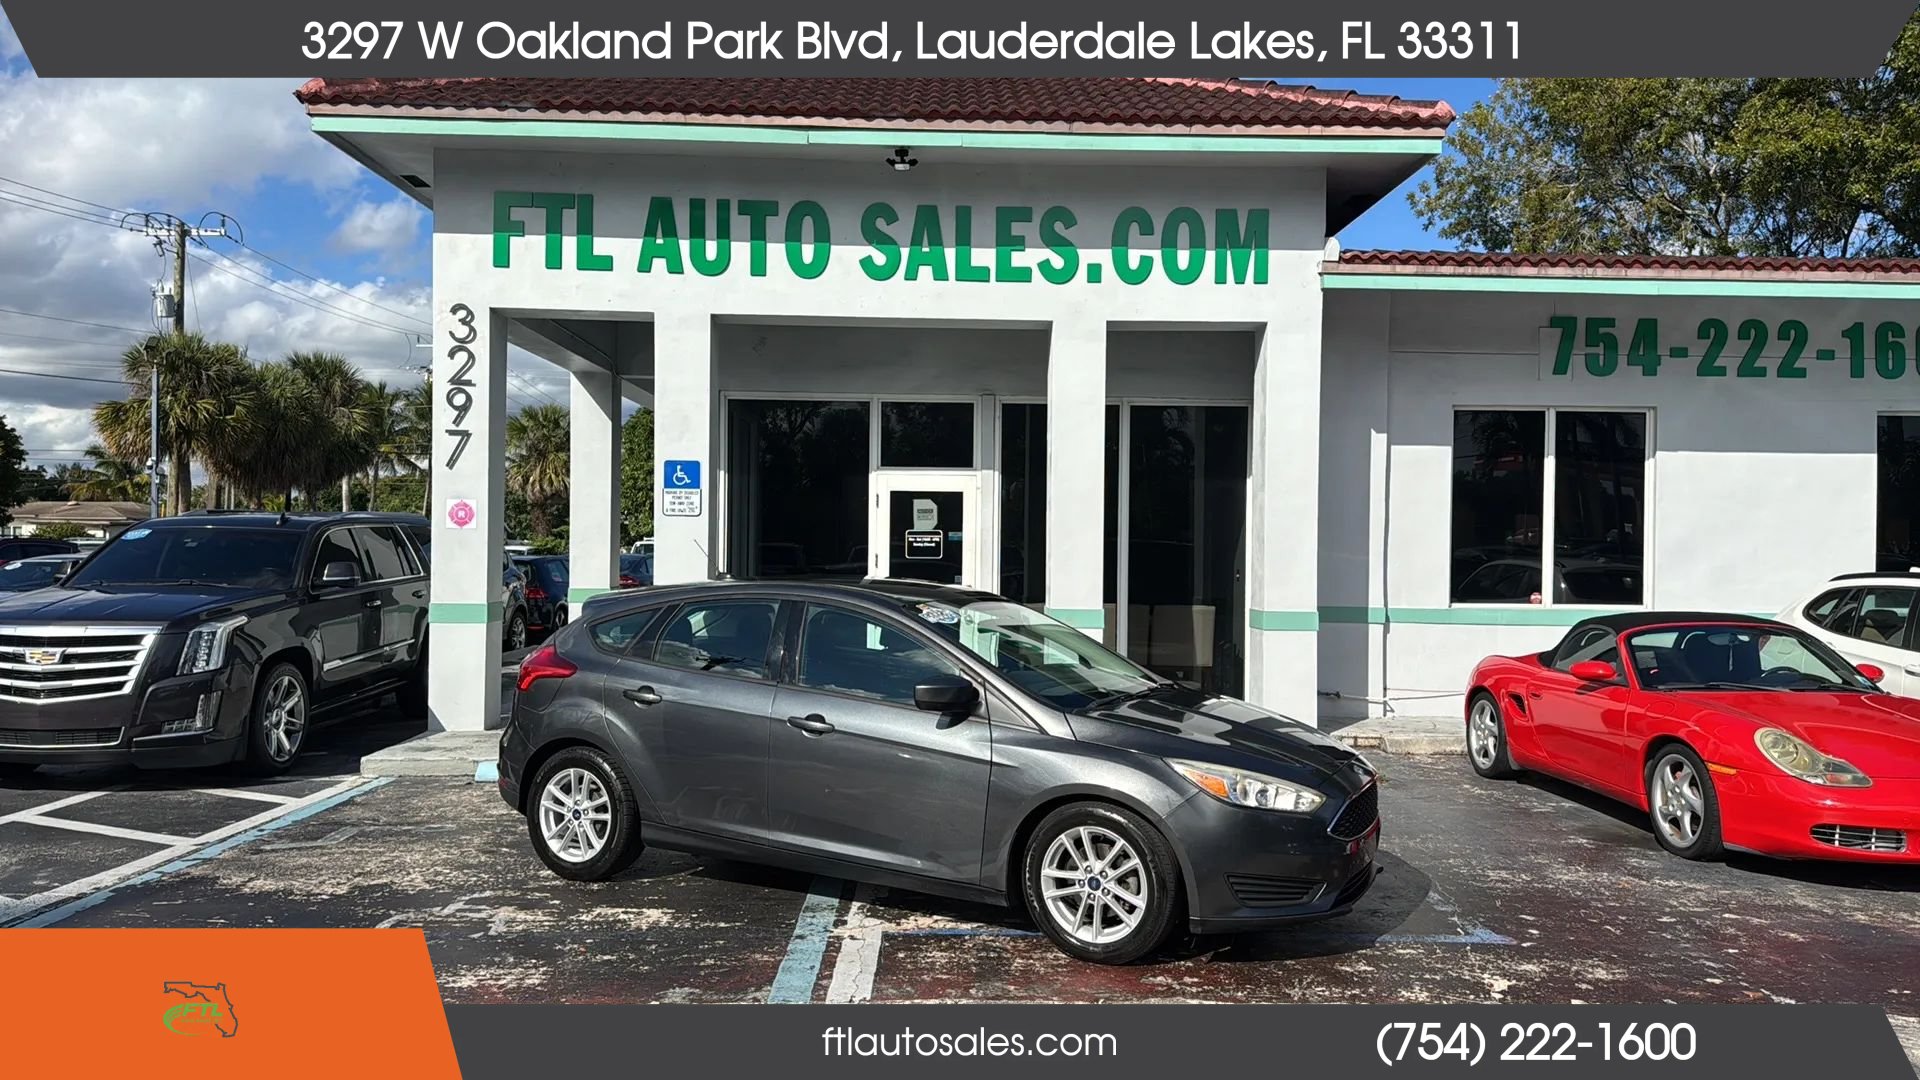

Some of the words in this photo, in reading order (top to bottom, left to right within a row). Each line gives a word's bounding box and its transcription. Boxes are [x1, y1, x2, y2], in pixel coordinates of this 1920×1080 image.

[491, 190, 613, 272] FTL
[637, 196, 832, 280] AUTO
[858, 201, 1270, 286] SALES.COM
[445, 302, 477, 471] 3297
[1550, 315, 1920, 380] 754-222-16
